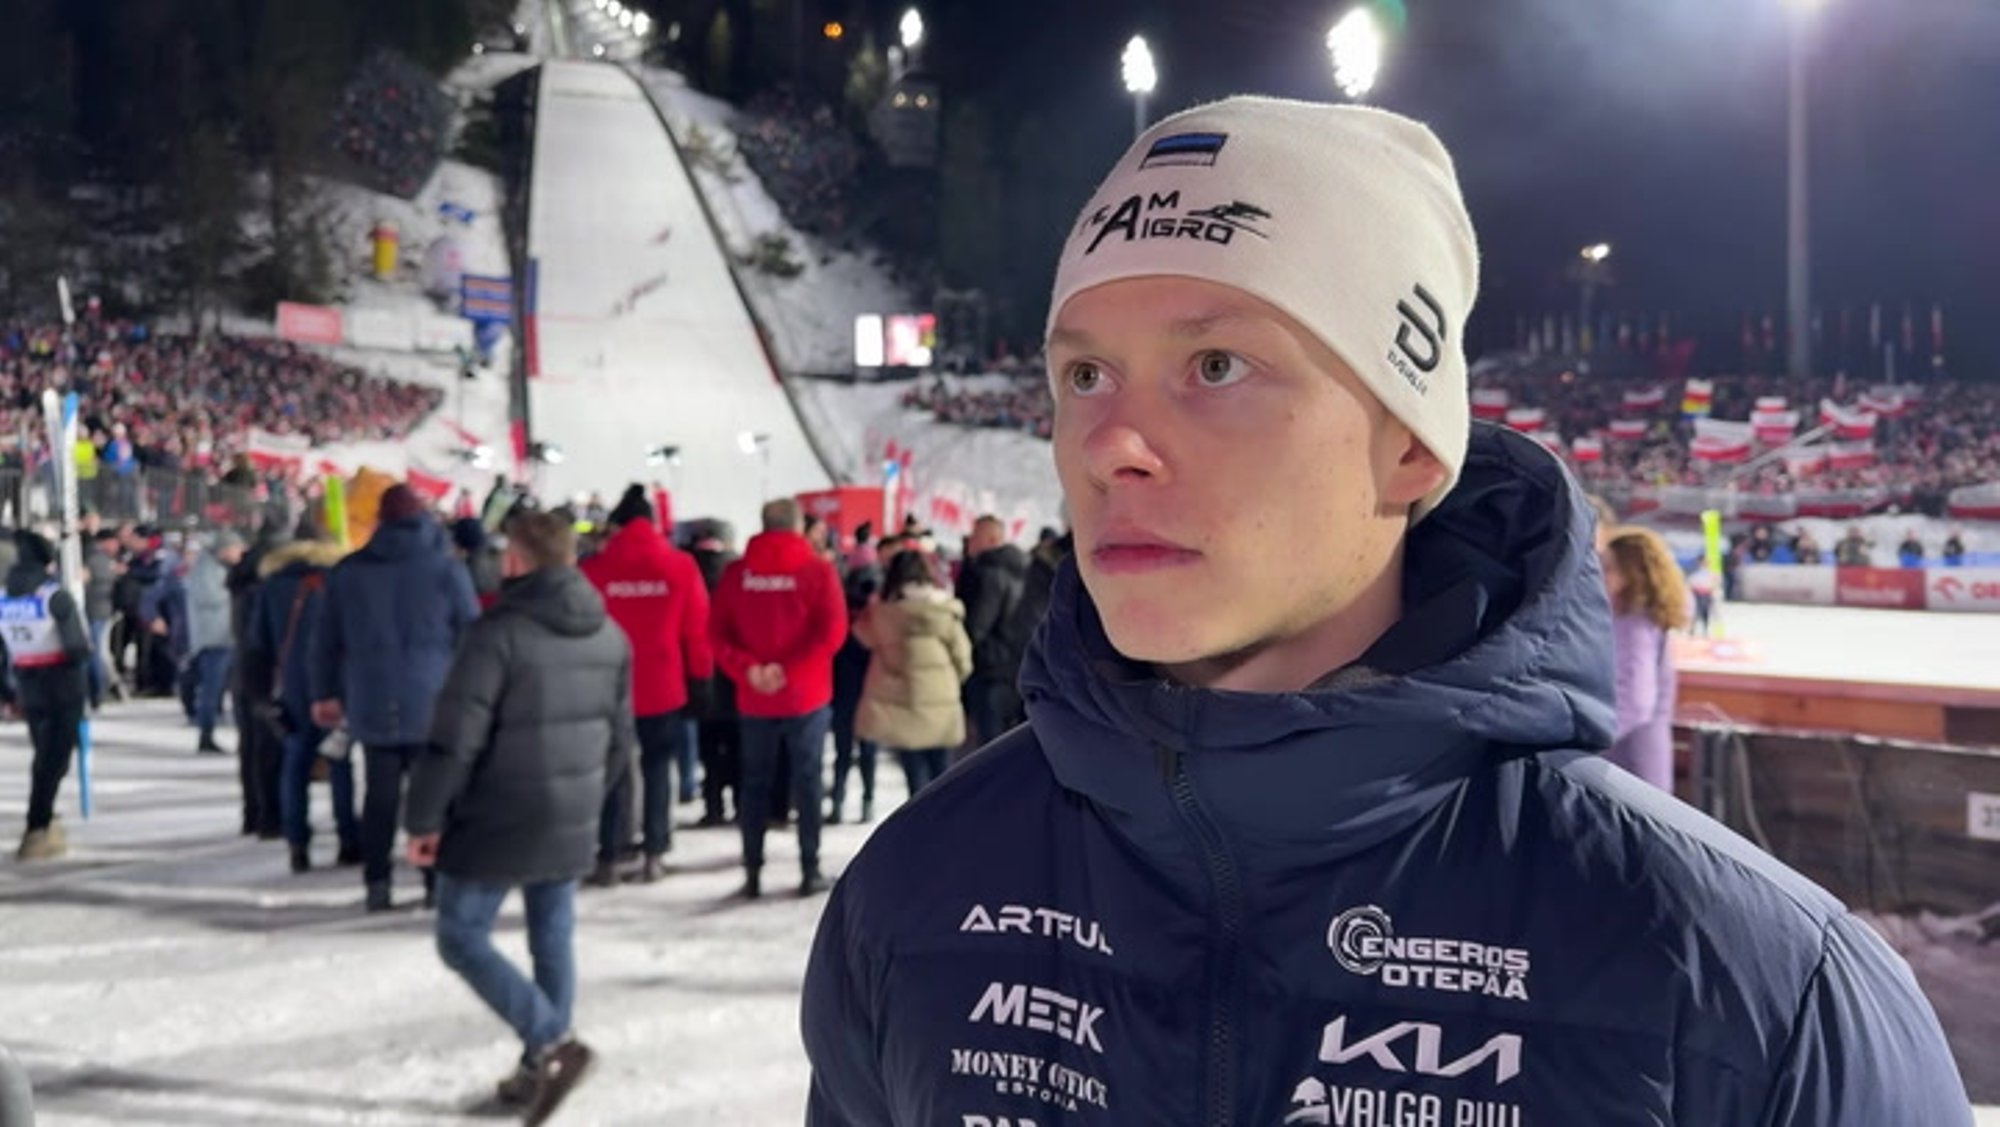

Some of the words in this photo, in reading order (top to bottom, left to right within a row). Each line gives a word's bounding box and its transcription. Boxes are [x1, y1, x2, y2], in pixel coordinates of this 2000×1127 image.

[959, 904, 1114, 956] ARTFUL
[1382, 962, 1529, 1000] OTEPÄÄ
[968, 982, 1105, 1053] MEEK
[951, 1049, 1044, 1083] MONEY
[1048, 1063, 1108, 1110] OFICE
[1330, 1085, 1442, 1127] VALGA
